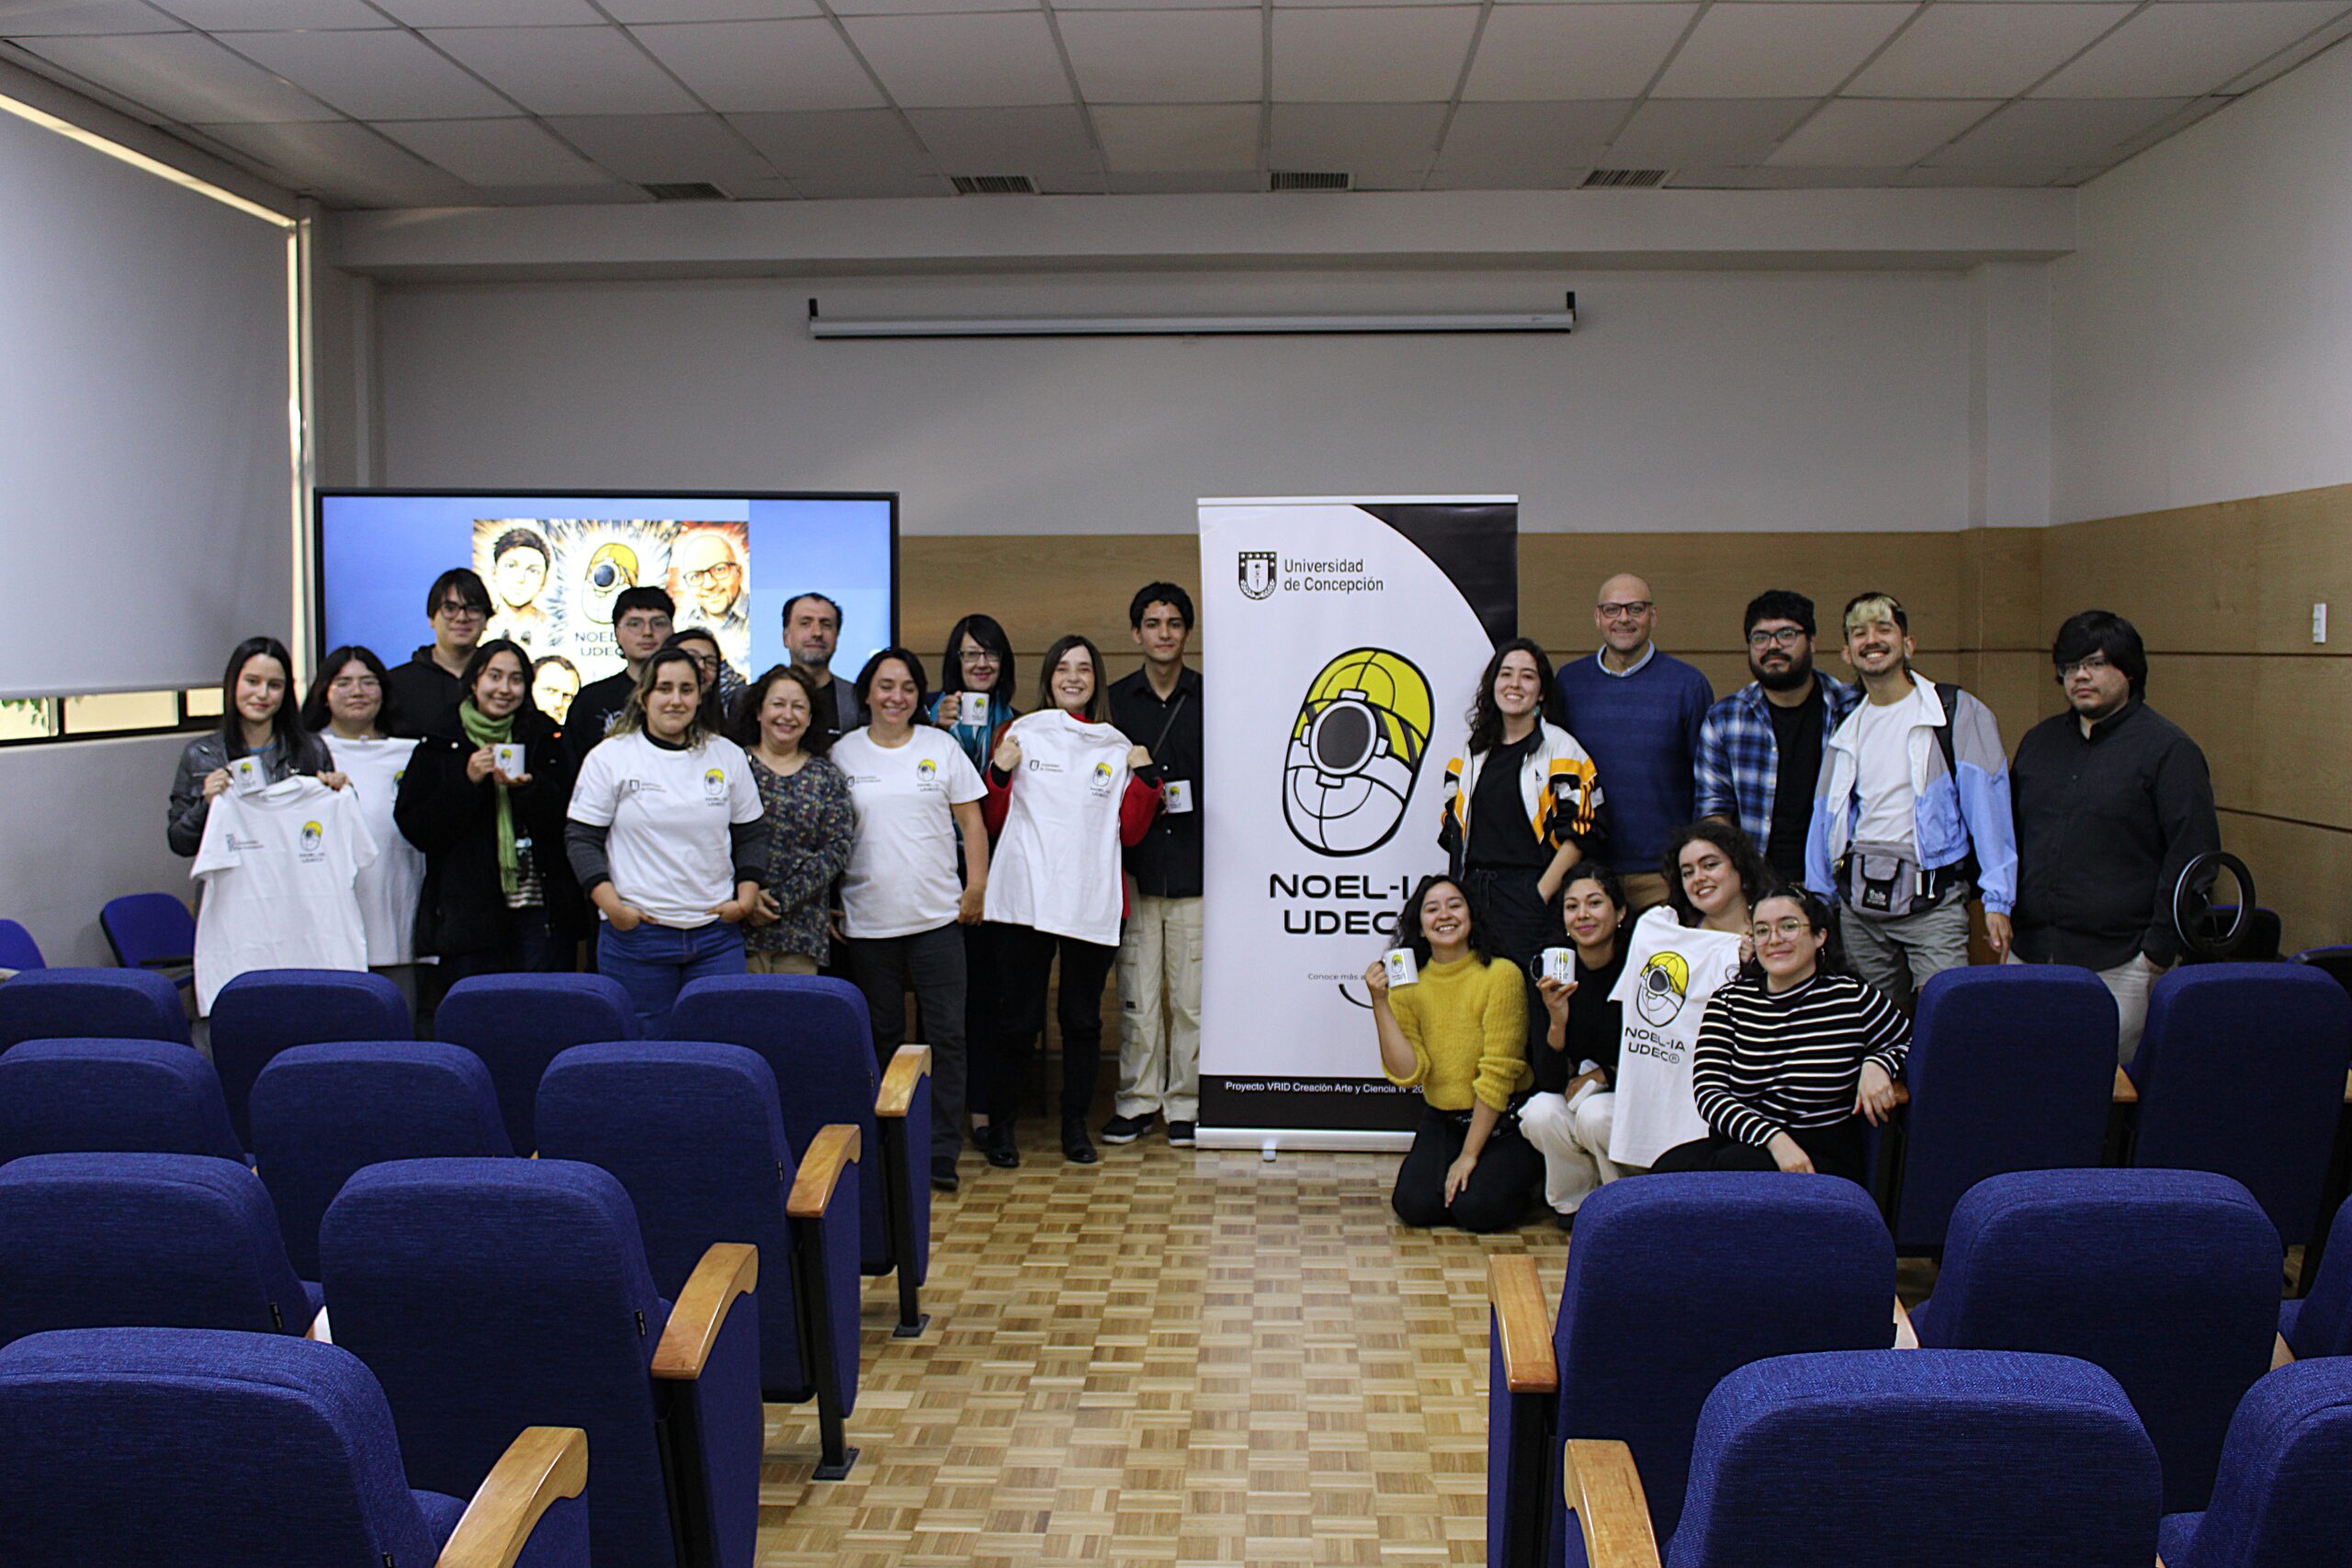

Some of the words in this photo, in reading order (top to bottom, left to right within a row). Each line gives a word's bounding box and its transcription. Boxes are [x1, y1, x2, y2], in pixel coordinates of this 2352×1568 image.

[1284, 558, 1363, 573] Universidad
[1283, 577, 1300, 591] de
[1304, 576, 1384, 594] Concepción
[574, 631, 617, 643] NOEL
[1270, 874, 1408, 899] NOEL-I
[1283, 909, 1398, 935] UDEC
[1307, 973, 1339, 981] Conoce
[1340, 972, 1359, 981] más
[1624, 1026, 1686, 1052] NOEL-IA
[1226, 1081, 1265, 1093] Proyecto
[1267, 1082, 1291, 1091] VRID
[1293, 1082, 1332, 1092] Creación
[1334, 1083, 1352, 1093] Arte
[1355, 1085, 1361, 1095] y
[1363, 1083, 1396, 1093] Ciencia
